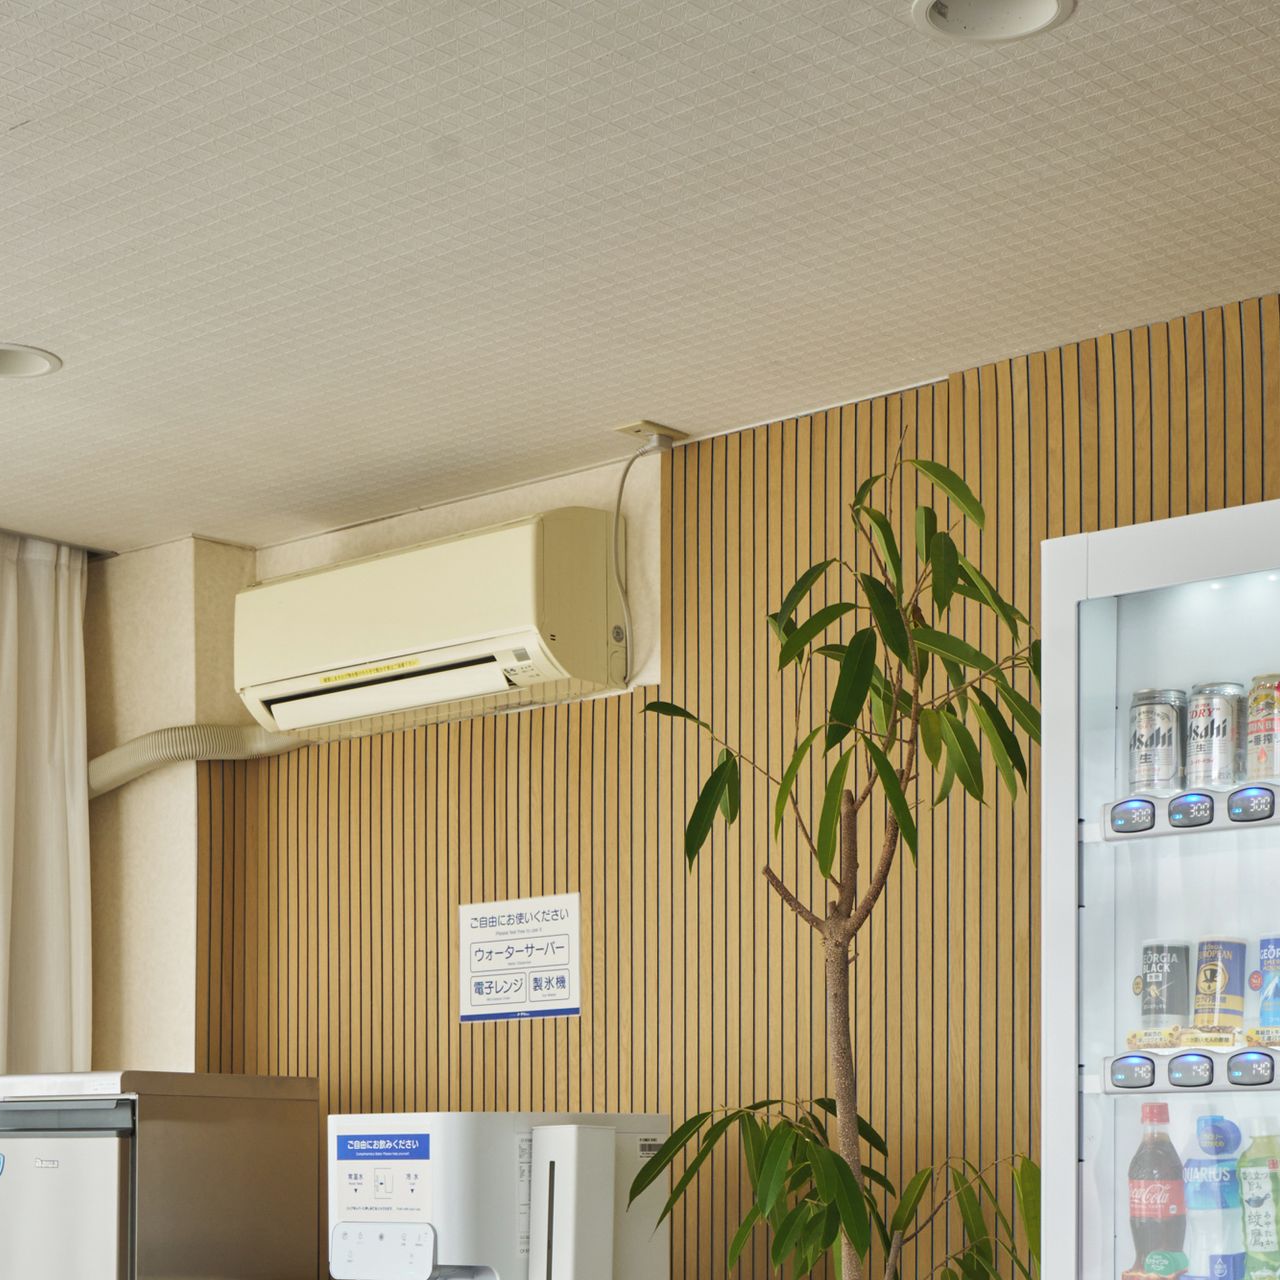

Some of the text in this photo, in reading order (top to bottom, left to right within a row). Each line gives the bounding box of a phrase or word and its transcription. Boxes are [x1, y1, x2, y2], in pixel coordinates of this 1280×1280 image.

[1196, 743, 1207, 753] 生
[1139, 753, 1153, 764] 生
[1190, 802, 1210, 818] 300
[1250, 796, 1271, 813] 300
[1131, 809, 1151, 824] 300
[471, 909, 569, 929] ご自由にお使いください
[474, 941, 565, 962] ウォーターサーバー
[474, 978, 523, 995] 電子レンジ
[533, 976, 566, 992] 製氷機
[1253, 1062, 1270, 1075] 140
[347, 1140, 419, 1150] ご自由にお飲みください
